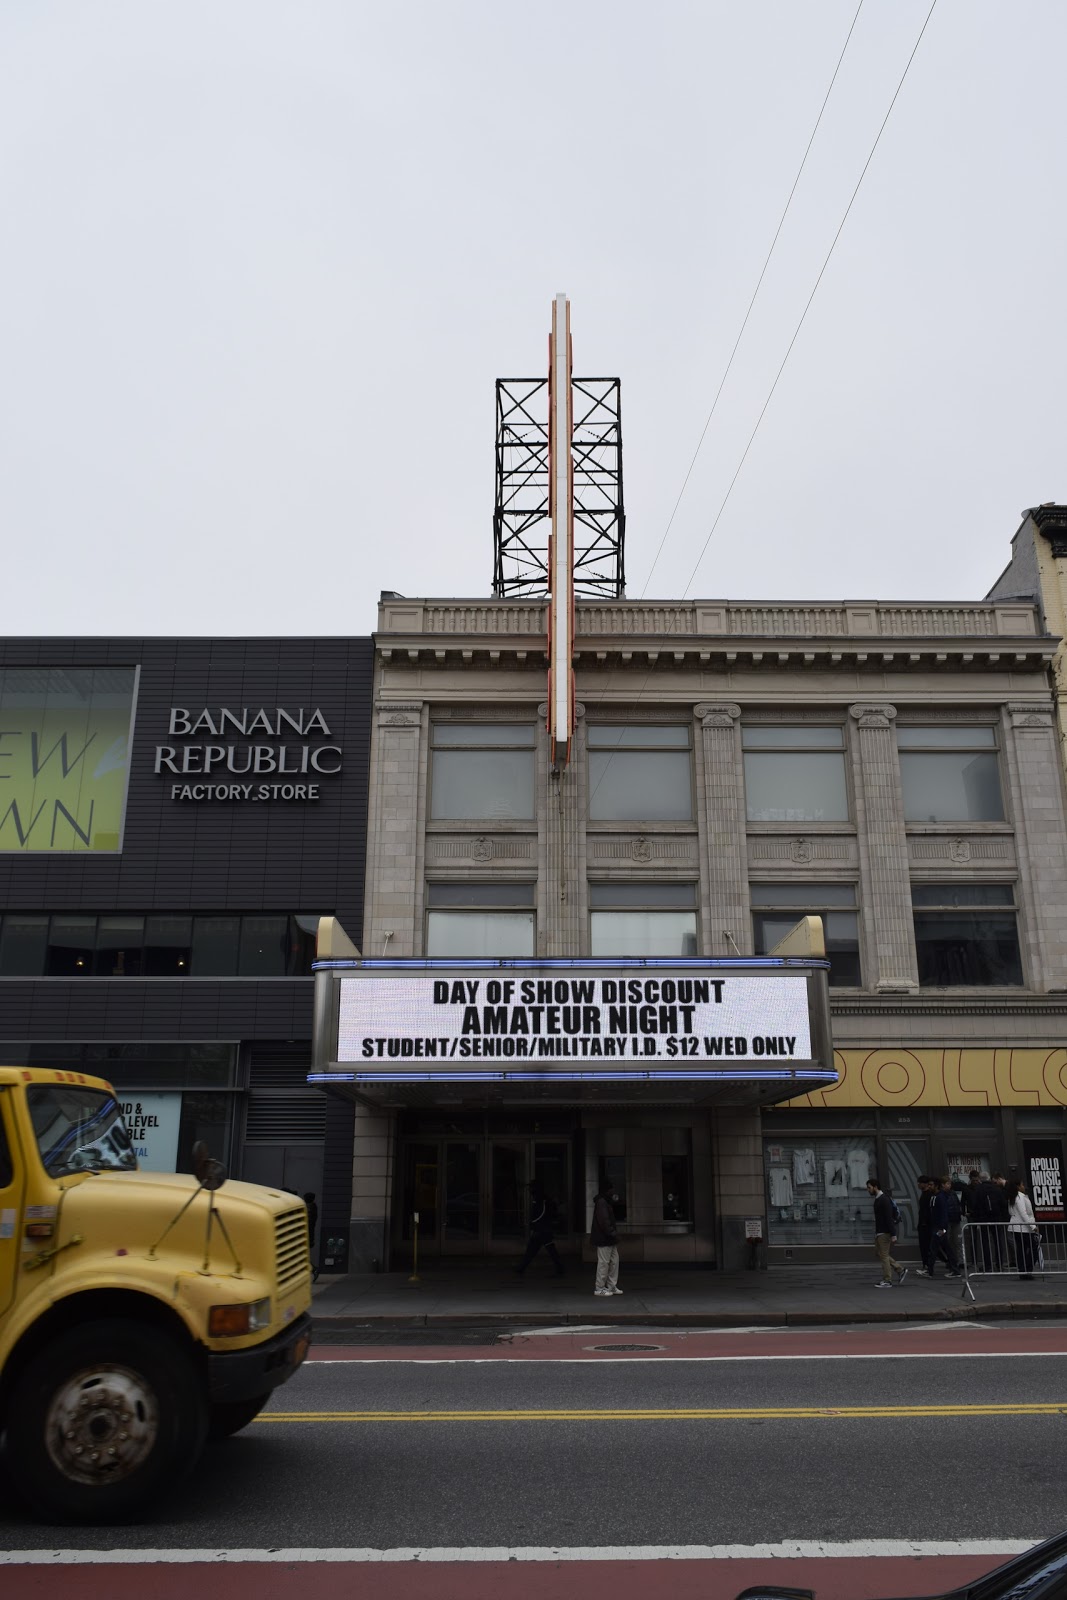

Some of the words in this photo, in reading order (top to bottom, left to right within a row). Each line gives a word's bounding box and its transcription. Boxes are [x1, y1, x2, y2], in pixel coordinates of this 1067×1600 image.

[168, 707, 331, 735] BANANA
[154, 745, 342, 774] REPUBLIC
[171, 784, 252, 800] FACTORY
[258, 784, 319, 800] STORE
[434, 980, 479, 1004] DAY
[486, 980, 515, 1004] OF
[521, 980, 595, 1004] SHOW
[602, 979, 725, 1004] DISCOUNT
[462, 1006, 601, 1034] AMATEUR
[609, 1005, 695, 1034] NIGHT
[362, 1037, 627, 1057] STUDENT/SENIOR/MILITARY
[632, 1037, 661, 1056] I.D.
[666, 1035, 699, 1057] $12
[704, 1036, 747, 1056] WED
[752, 1036, 796, 1055] ONLY
[135, 1103, 142, 1115] &
[128, 1115, 159, 1127] LEVEL
[1030, 1157, 1060, 1171] APOLLO
[1031, 1170, 1062, 1186] MUSIC
[1033, 1185, 1064, 1206] CAFE
